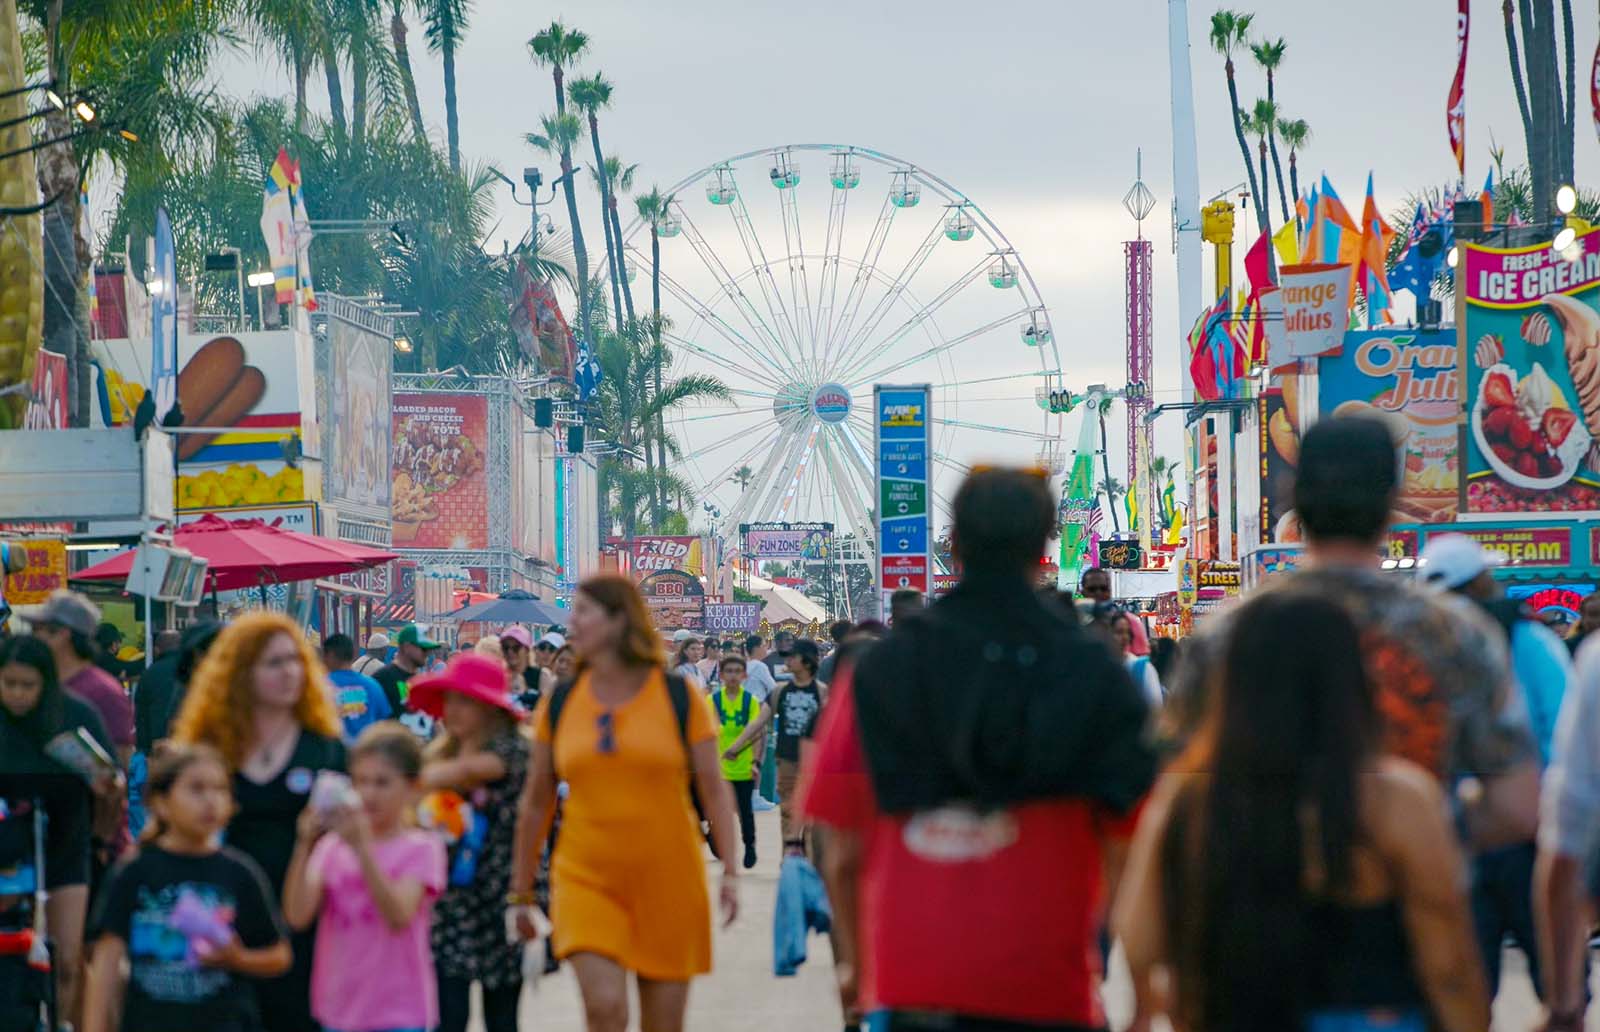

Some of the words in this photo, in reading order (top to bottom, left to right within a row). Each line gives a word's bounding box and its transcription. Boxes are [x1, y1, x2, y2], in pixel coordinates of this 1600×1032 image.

[1502, 238, 1586, 272] FRESH-ME
[1478, 270, 1519, 301] ICE
[433, 426, 461, 435] TOTS
[639, 540, 688, 557] FRIED
[760, 540, 777, 551] FUN
[779, 540, 801, 551] ZONE
[656, 582, 684, 597] BBQ
[705, 605, 756, 618] KETTLE
[713, 617, 748, 629] CORN
